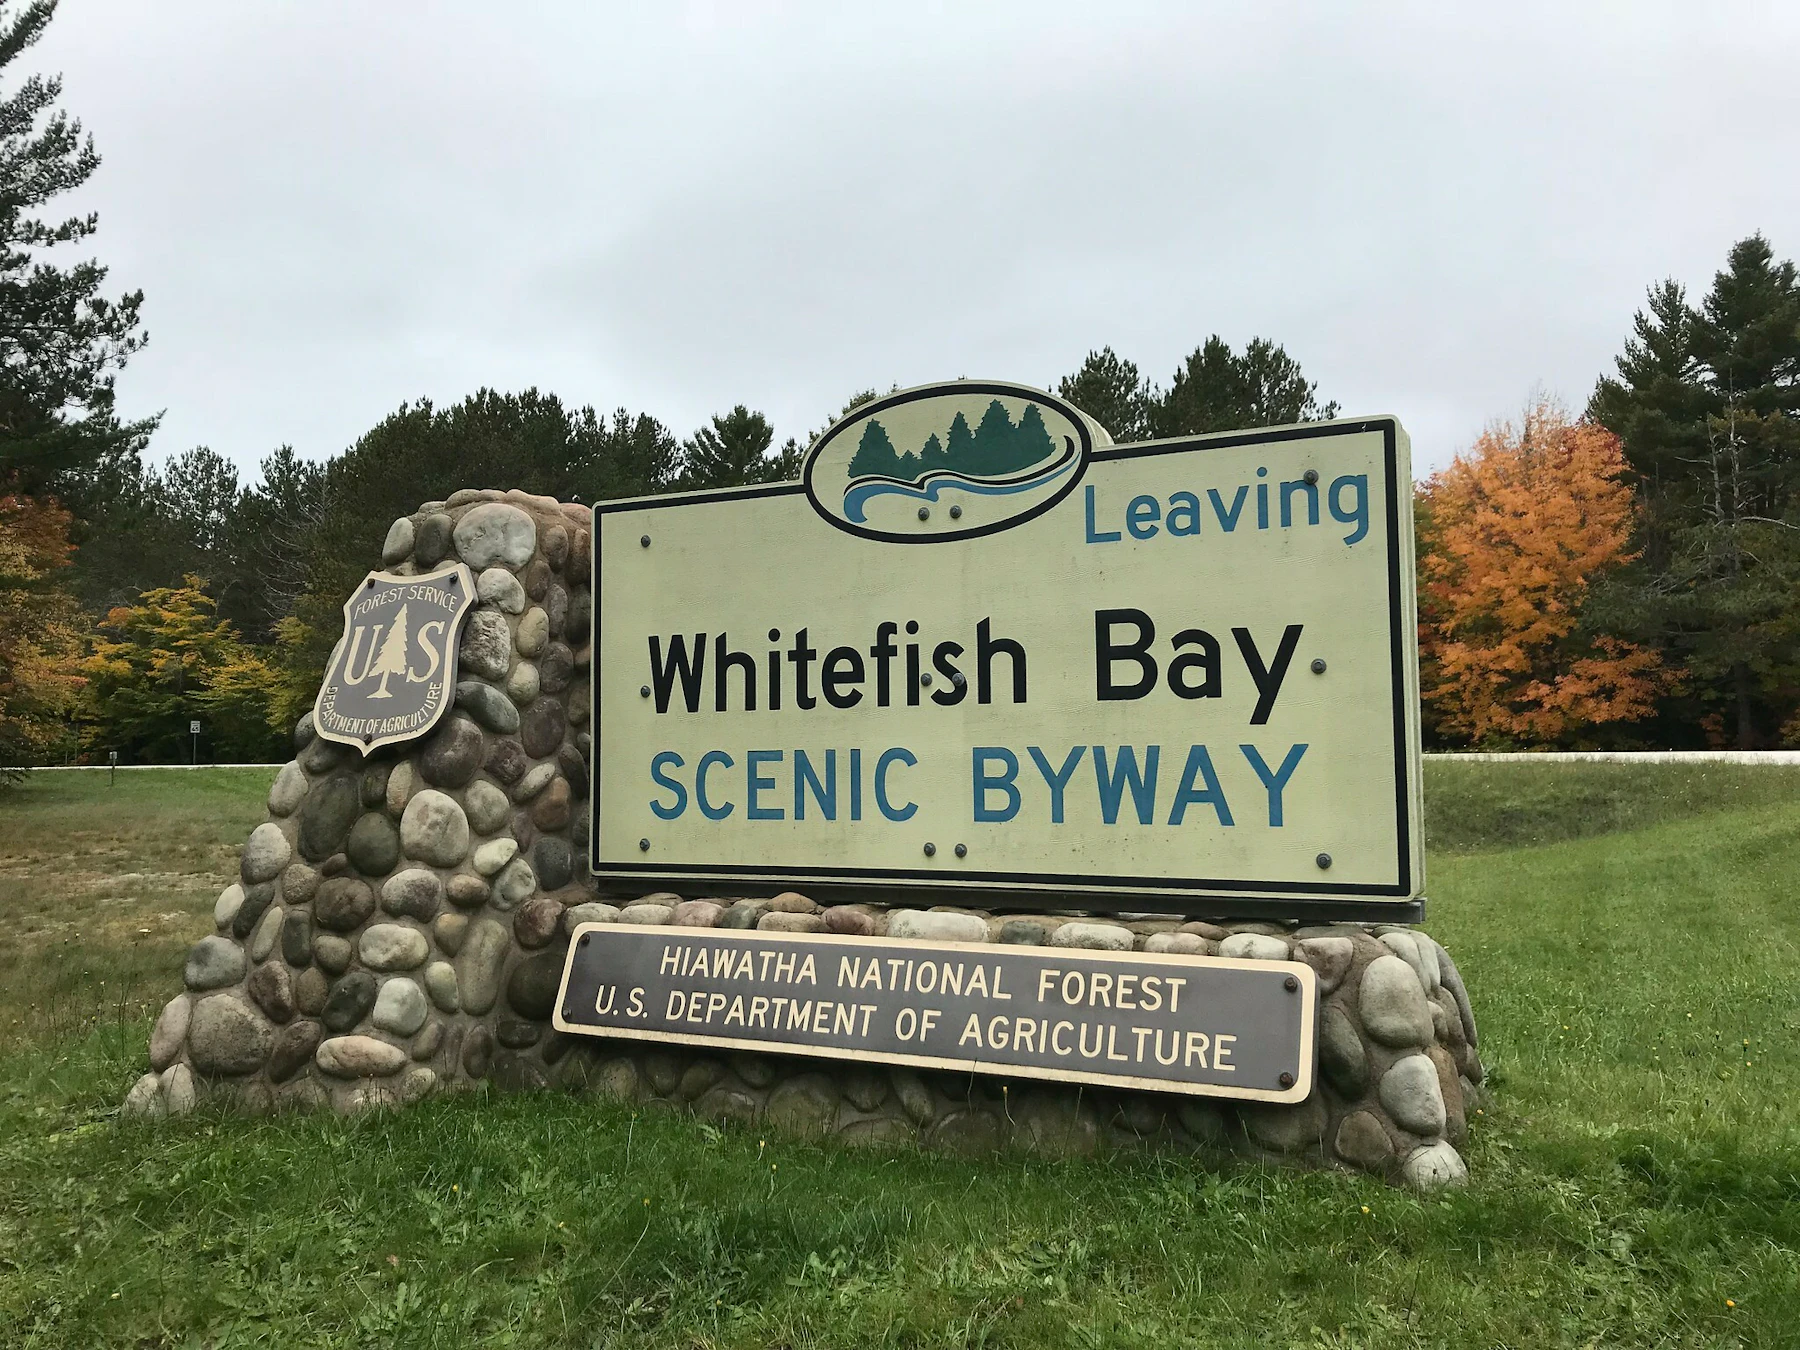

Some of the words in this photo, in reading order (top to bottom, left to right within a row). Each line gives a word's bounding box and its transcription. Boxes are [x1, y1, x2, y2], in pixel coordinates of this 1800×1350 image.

[1085, 467, 1369, 545] Leaving
[354, 587, 406, 620] FOREST
[407, 585, 458, 613] SERVICE
[648, 617, 1027, 713] Whitefish
[1095, 609, 1304, 725] Bay
[322, 686, 367, 734] DEPARTMENT
[366, 719, 380, 734] OF
[379, 682, 443, 734] AGRICULTURE
[650, 748, 918, 822] SCENIC
[972, 744, 1308, 828] BYWAY
[660, 946, 816, 985] HIAWATHA
[838, 956, 1011, 999] NATIONAL
[1038, 969, 1186, 1012] FOREST
[596, 985, 649, 1018] U.S.
[666, 991, 874, 1037] DEPARTMENT
[896, 1008, 941, 1041] OF
[959, 1014, 1237, 1071] AGRICULTURE
